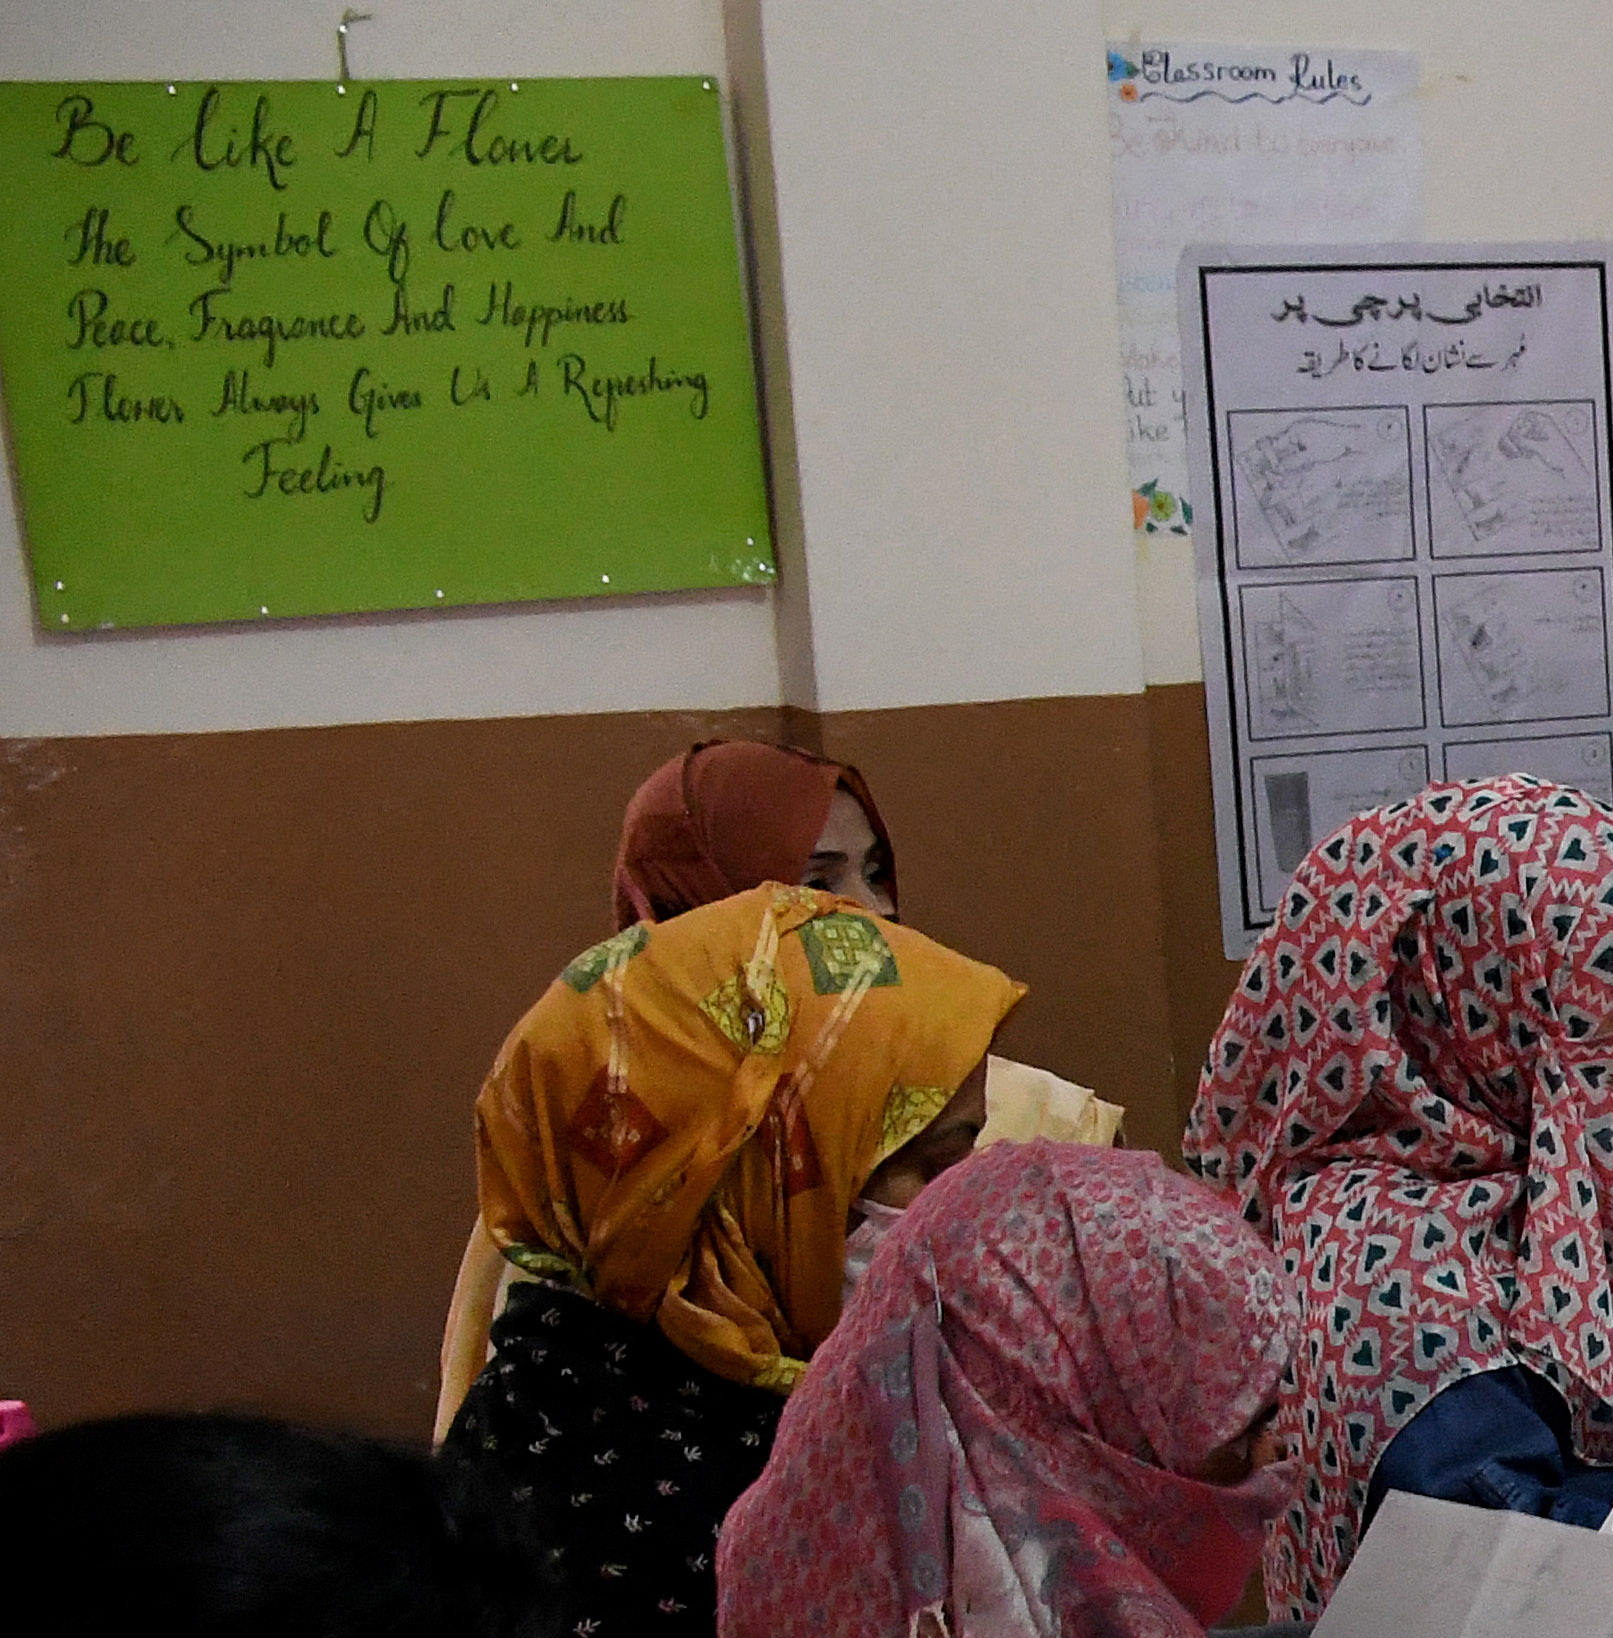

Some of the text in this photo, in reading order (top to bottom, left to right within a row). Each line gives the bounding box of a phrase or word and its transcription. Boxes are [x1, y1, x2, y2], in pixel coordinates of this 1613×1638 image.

[1141, 50, 1363, 90] Classroom Rules
[51, 95, 139, 167] Be
[334, 90, 377, 163] A
[164, 205, 336, 284] Symbol
[546, 190, 627, 245] And
[381, 282, 456, 335] And
[476, 281, 628, 347] Happiness
[519, 358, 539, 397] A
[242, 437, 384, 523] Feeling
